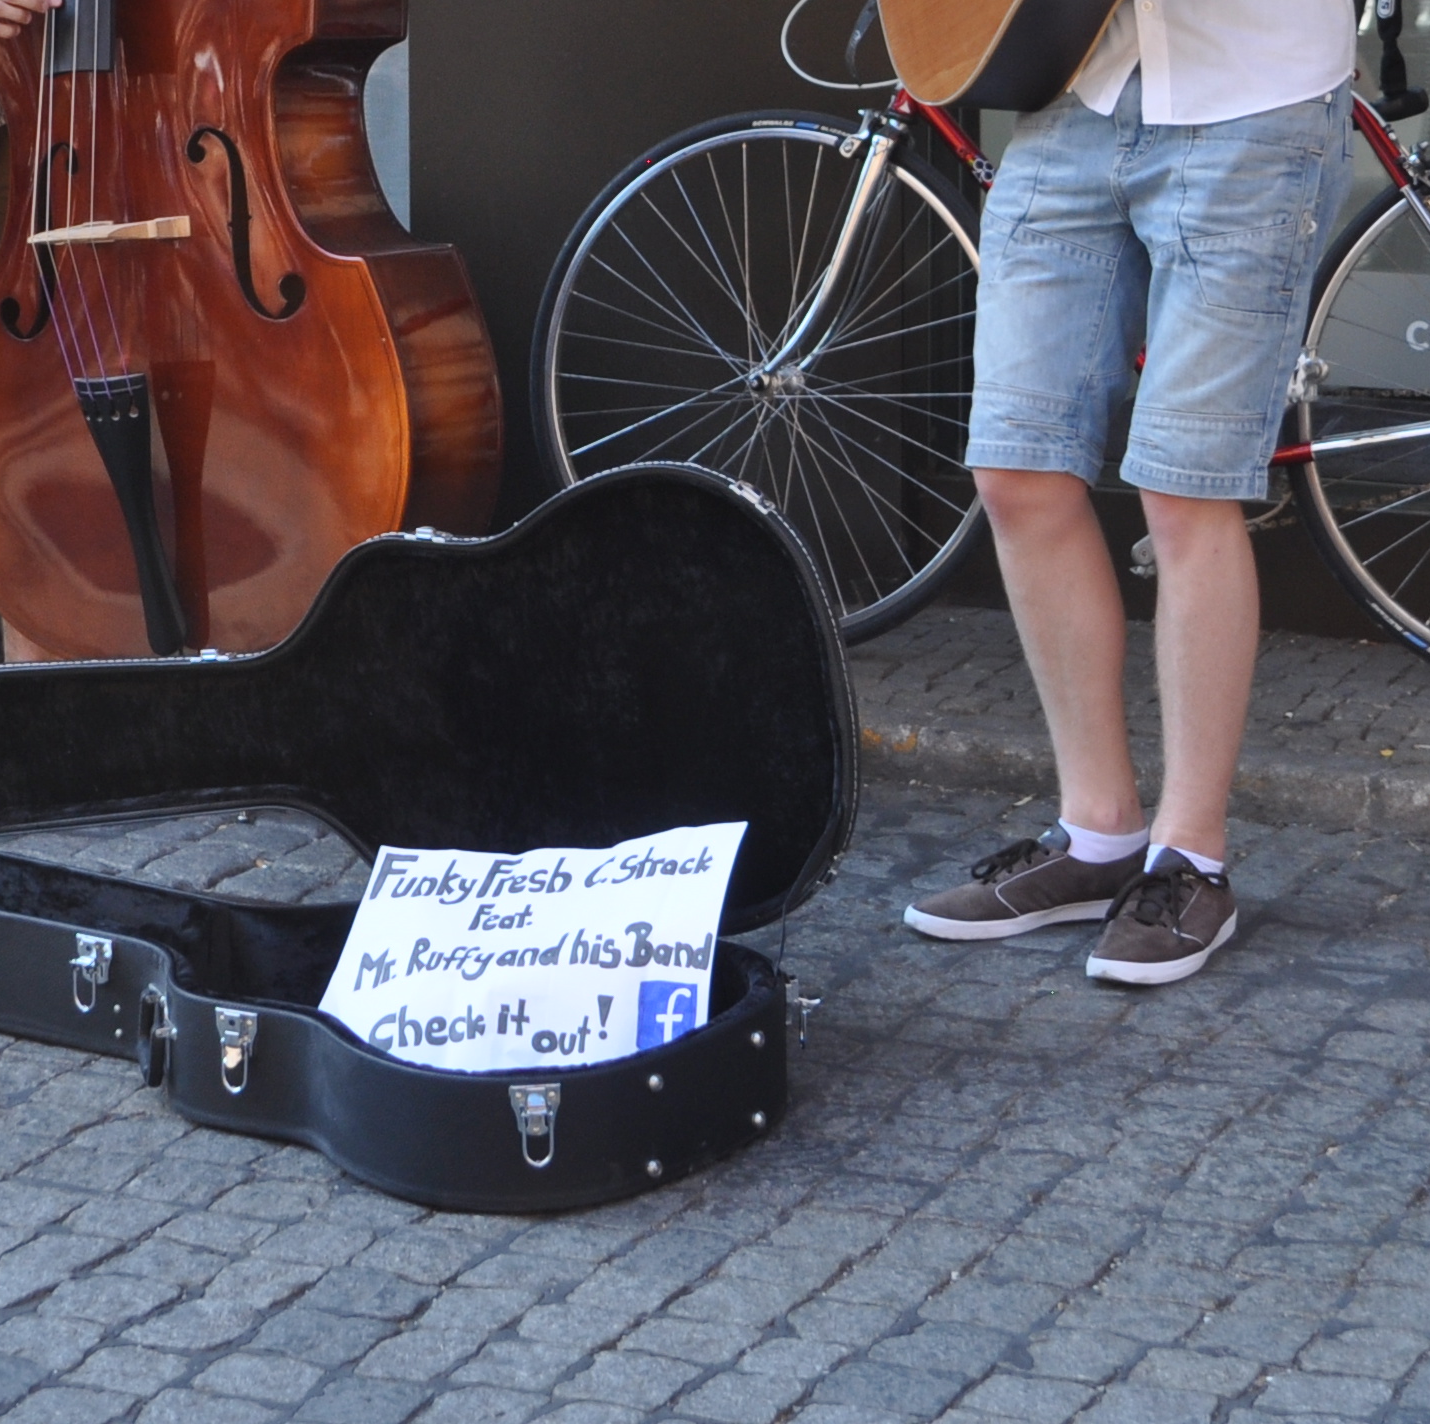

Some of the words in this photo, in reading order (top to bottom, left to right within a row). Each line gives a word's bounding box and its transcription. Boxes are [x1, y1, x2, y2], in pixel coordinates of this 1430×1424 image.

[369, 852, 479, 905] Funky
[475, 856, 573, 899] Fresh
[468, 903, 533, 931] Feat.
[353, 947, 397, 991] Mr.
[406, 937, 495, 981] Ruffy
[495, 931, 570, 967] and
[569, 928, 622, 968] his
[624, 921, 713, 971] Band
[497, 998, 530, 1036] it
